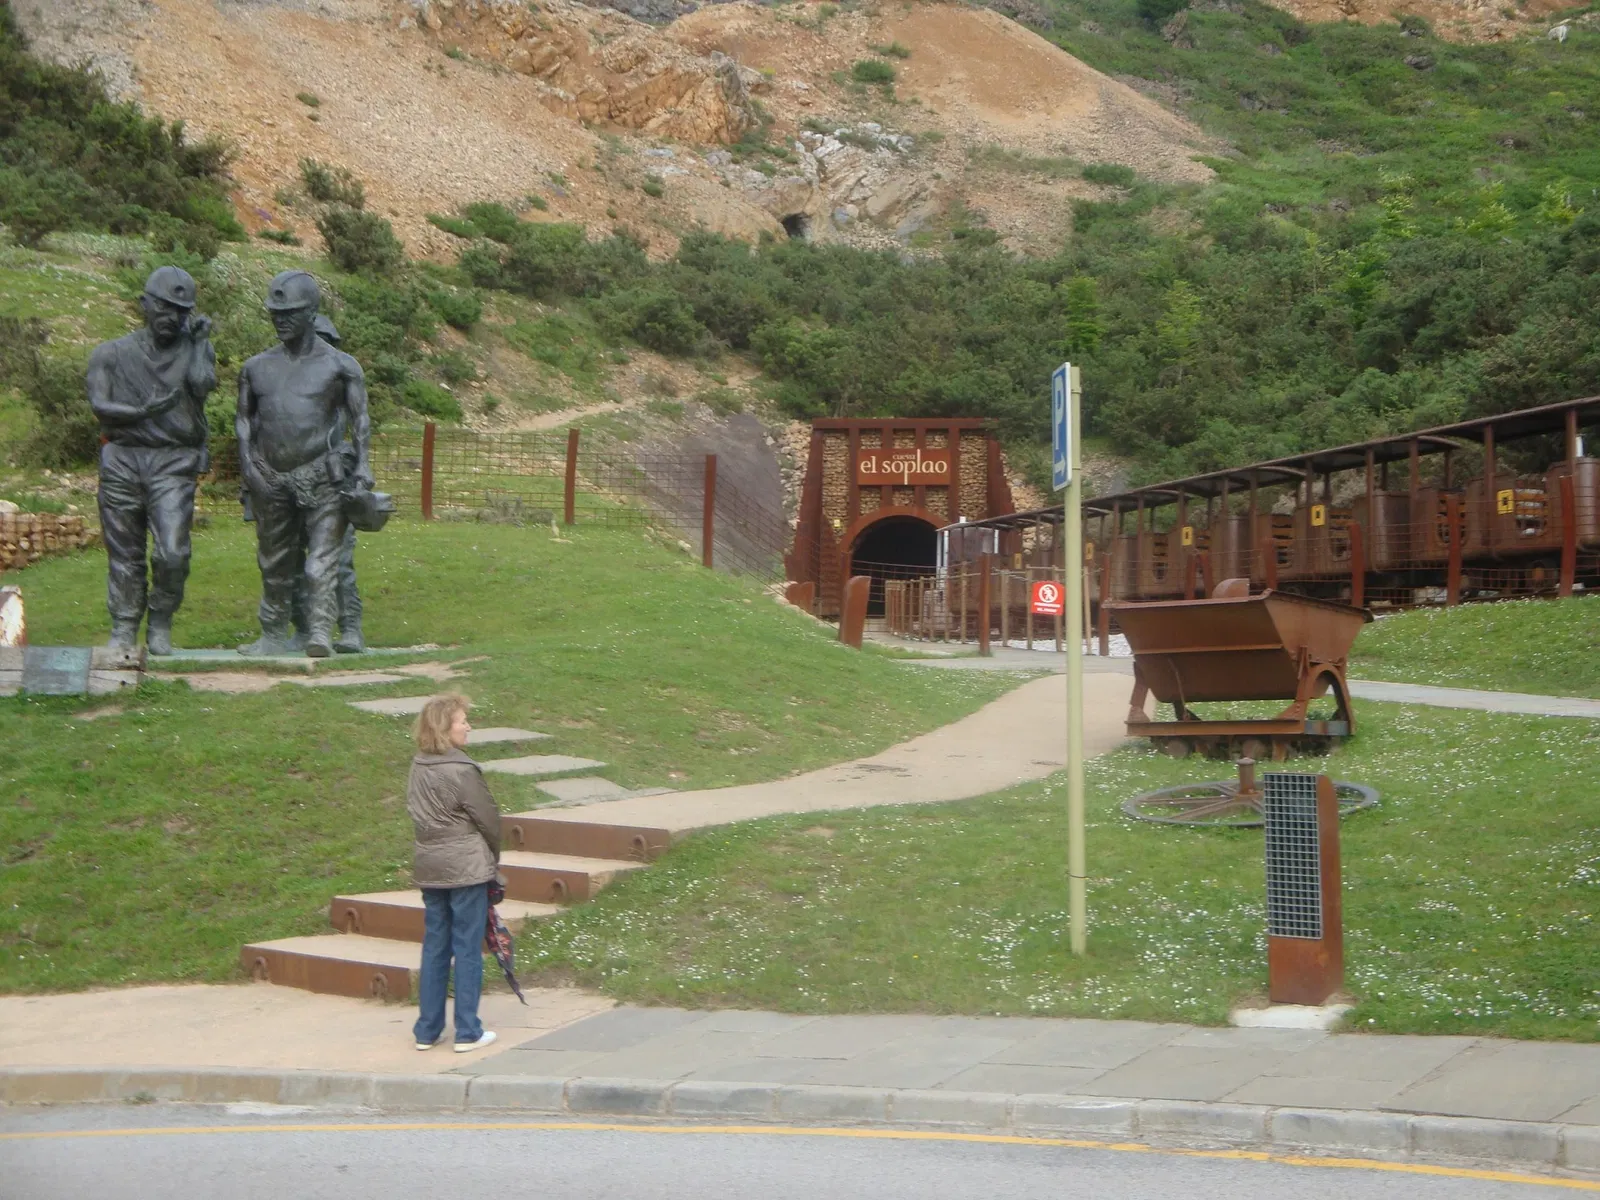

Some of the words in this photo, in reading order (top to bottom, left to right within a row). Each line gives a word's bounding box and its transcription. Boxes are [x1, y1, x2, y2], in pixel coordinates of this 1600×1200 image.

[1054, 375, 1064, 450] P
[860, 455, 877, 474] el
[881, 448, 947, 485] soplao
